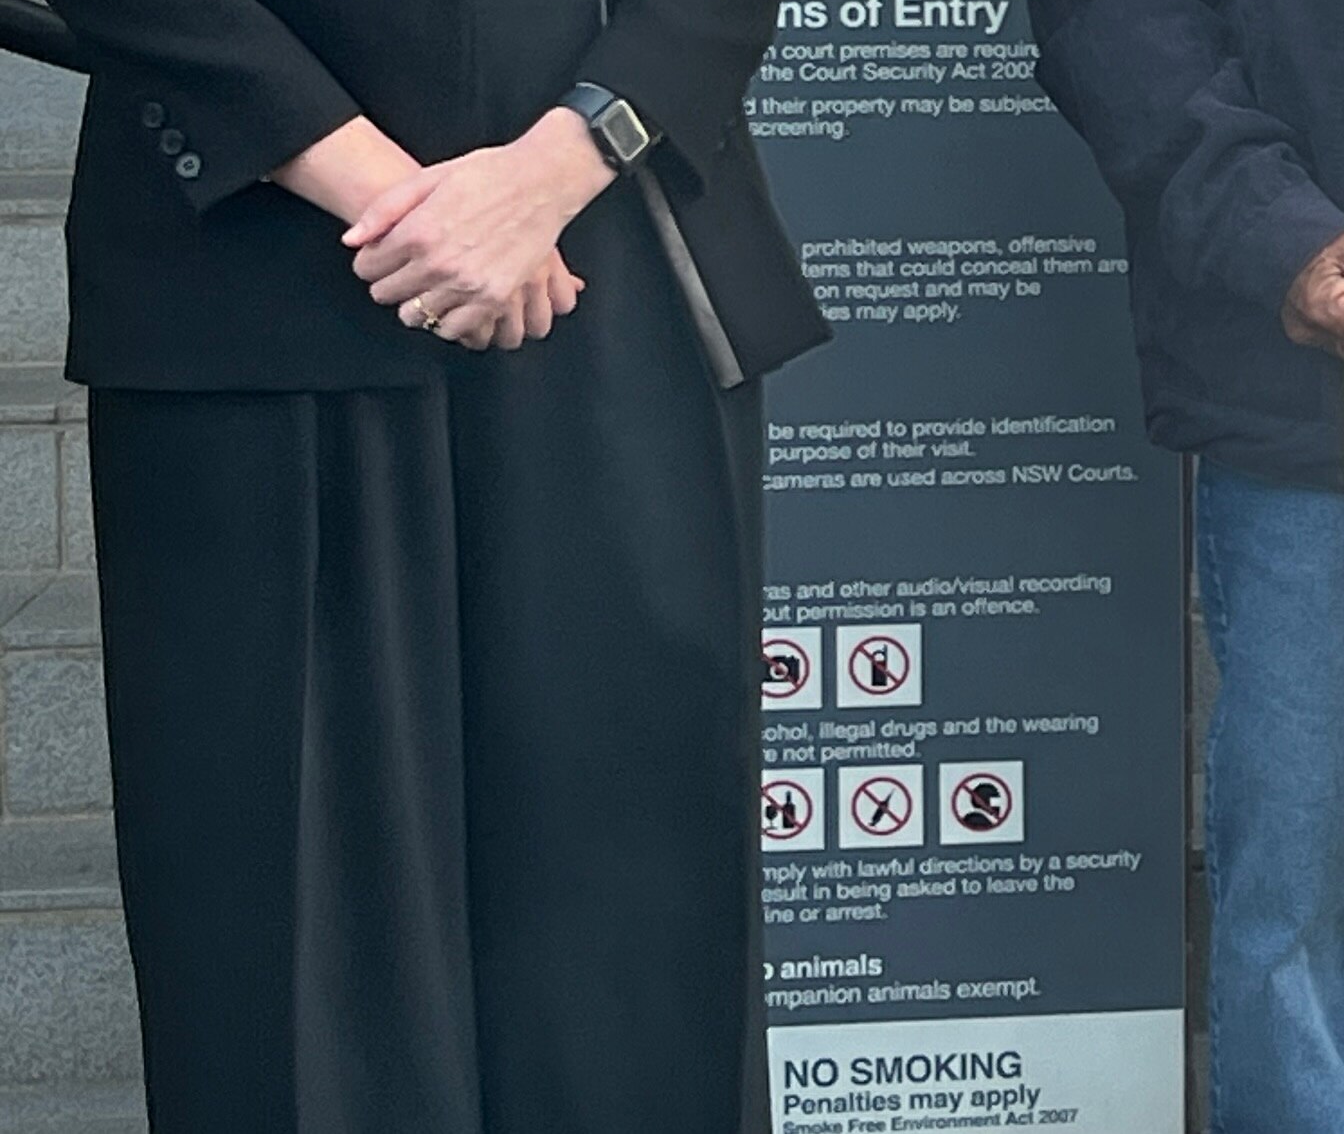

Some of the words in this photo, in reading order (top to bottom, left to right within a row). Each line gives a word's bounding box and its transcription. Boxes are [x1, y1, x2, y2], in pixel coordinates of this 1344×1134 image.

[777, 2, 827, 28] ns
[781, 43, 835, 60] court
[840, 41, 931, 62] premises
[936, 45, 968, 58] are
[974, 41, 1039, 60] requir
[760, 64, 794, 81] the
[799, 63, 857, 81] Court
[863, 63, 947, 82] Security
[951, 62, 985, 79] Act
[761, 97, 807, 115] their
[812, 98, 896, 116] property
[901, 99, 943, 116] may
[949, 95, 974, 112] be
[979, 97, 1057, 115] subject
[801, 239, 902, 261] prohibited
[907, 240, 1002, 258] weapons,
[1008, 236, 1095, 253] offensive
[801, 261, 851, 278] tems
[856, 261, 895, 277] that
[900, 259, 955, 277] could
[961, 258, 1037, 275] conceal
[1043, 258, 1092, 273] them
[1098, 259, 1128, 273] are
[814, 285, 839, 300] on
[845, 282, 919, 302] request
[925, 281, 962, 297] and
[968, 283, 1010, 299] may
[1016, 280, 1040, 295] be
[856, 306, 898, 323] may
[904, 302, 960, 322] apply.
[768, 423, 794, 440] be
[799, 420, 881, 441] required
[886, 421, 907, 437] to
[912, 418, 986, 440] provide
[992, 416, 1114, 434] identification
[769, 446, 851, 465] purpose
[857, 443, 877, 459] of
[882, 442, 926, 458] their
[931, 441, 974, 456] visit.
[850, 473, 882, 487] are
[887, 469, 936, 486] used
[941, 470, 1005, 485] across
[1013, 465, 1062, 483] NSW
[1068, 464, 1136, 482] Courts.
[796, 581, 834, 599] and
[840, 581, 891, 598] other
[896, 576, 1013, 596] audio/visual
[1019, 575, 1111, 594] recording
[797, 601, 904, 623] permission
[910, 601, 926, 616] is
[932, 602, 956, 616] an
[961, 599, 1038, 615] offence.
[762, 722, 813, 742] ohol,
[819, 720, 875, 741] illegal
[880, 720, 937, 740] drugs
[943, 718, 980, 735] and
[986, 717, 1017, 733] the
[1022, 717, 1098, 734] wearing
[783, 745, 815, 761] not
[821, 742, 921, 763] permitted.
[763, 863, 807, 884] mply
[812, 861, 852, 879] with
[858, 858, 914, 877] lawful
[919, 856, 1014, 875] directions
[1020, 854, 1043, 874] by
[1049, 856, 1061, 870] a
[1066, 851, 1141, 870] security
[761, 883, 808, 902] esult
[813, 883, 831, 899] in
[837, 881, 891, 900] being
[896, 878, 956, 897] asked
[961, 878, 981, 894] to
[987, 877, 1038, 893] leave
[1044, 874, 1074, 891] the
[764, 906, 794, 923] ine
[799, 908, 821, 922] or
[826, 903, 887, 921] arrest.
[781, 954, 882, 979] animals
[765, 985, 861, 1010] mpanion
[868, 980, 951, 1002] animals
[957, 977, 1040, 1000] exempt.
[784, 1058, 839, 1089] NO
[851, 1051, 1022, 1085] SMOKING
[784, 1091, 901, 1115] Penalties
[909, 1092, 963, 1112] may
[970, 1084, 1041, 1111] apply
[783, 1121, 843, 1134] Smoke
[848, 1119, 886, 1132] Free
[891, 1111, 1001, 1131] Environment
[1004, 1109, 1034, 1126] Act
[1038, 1108, 1079, 1124] 2007
